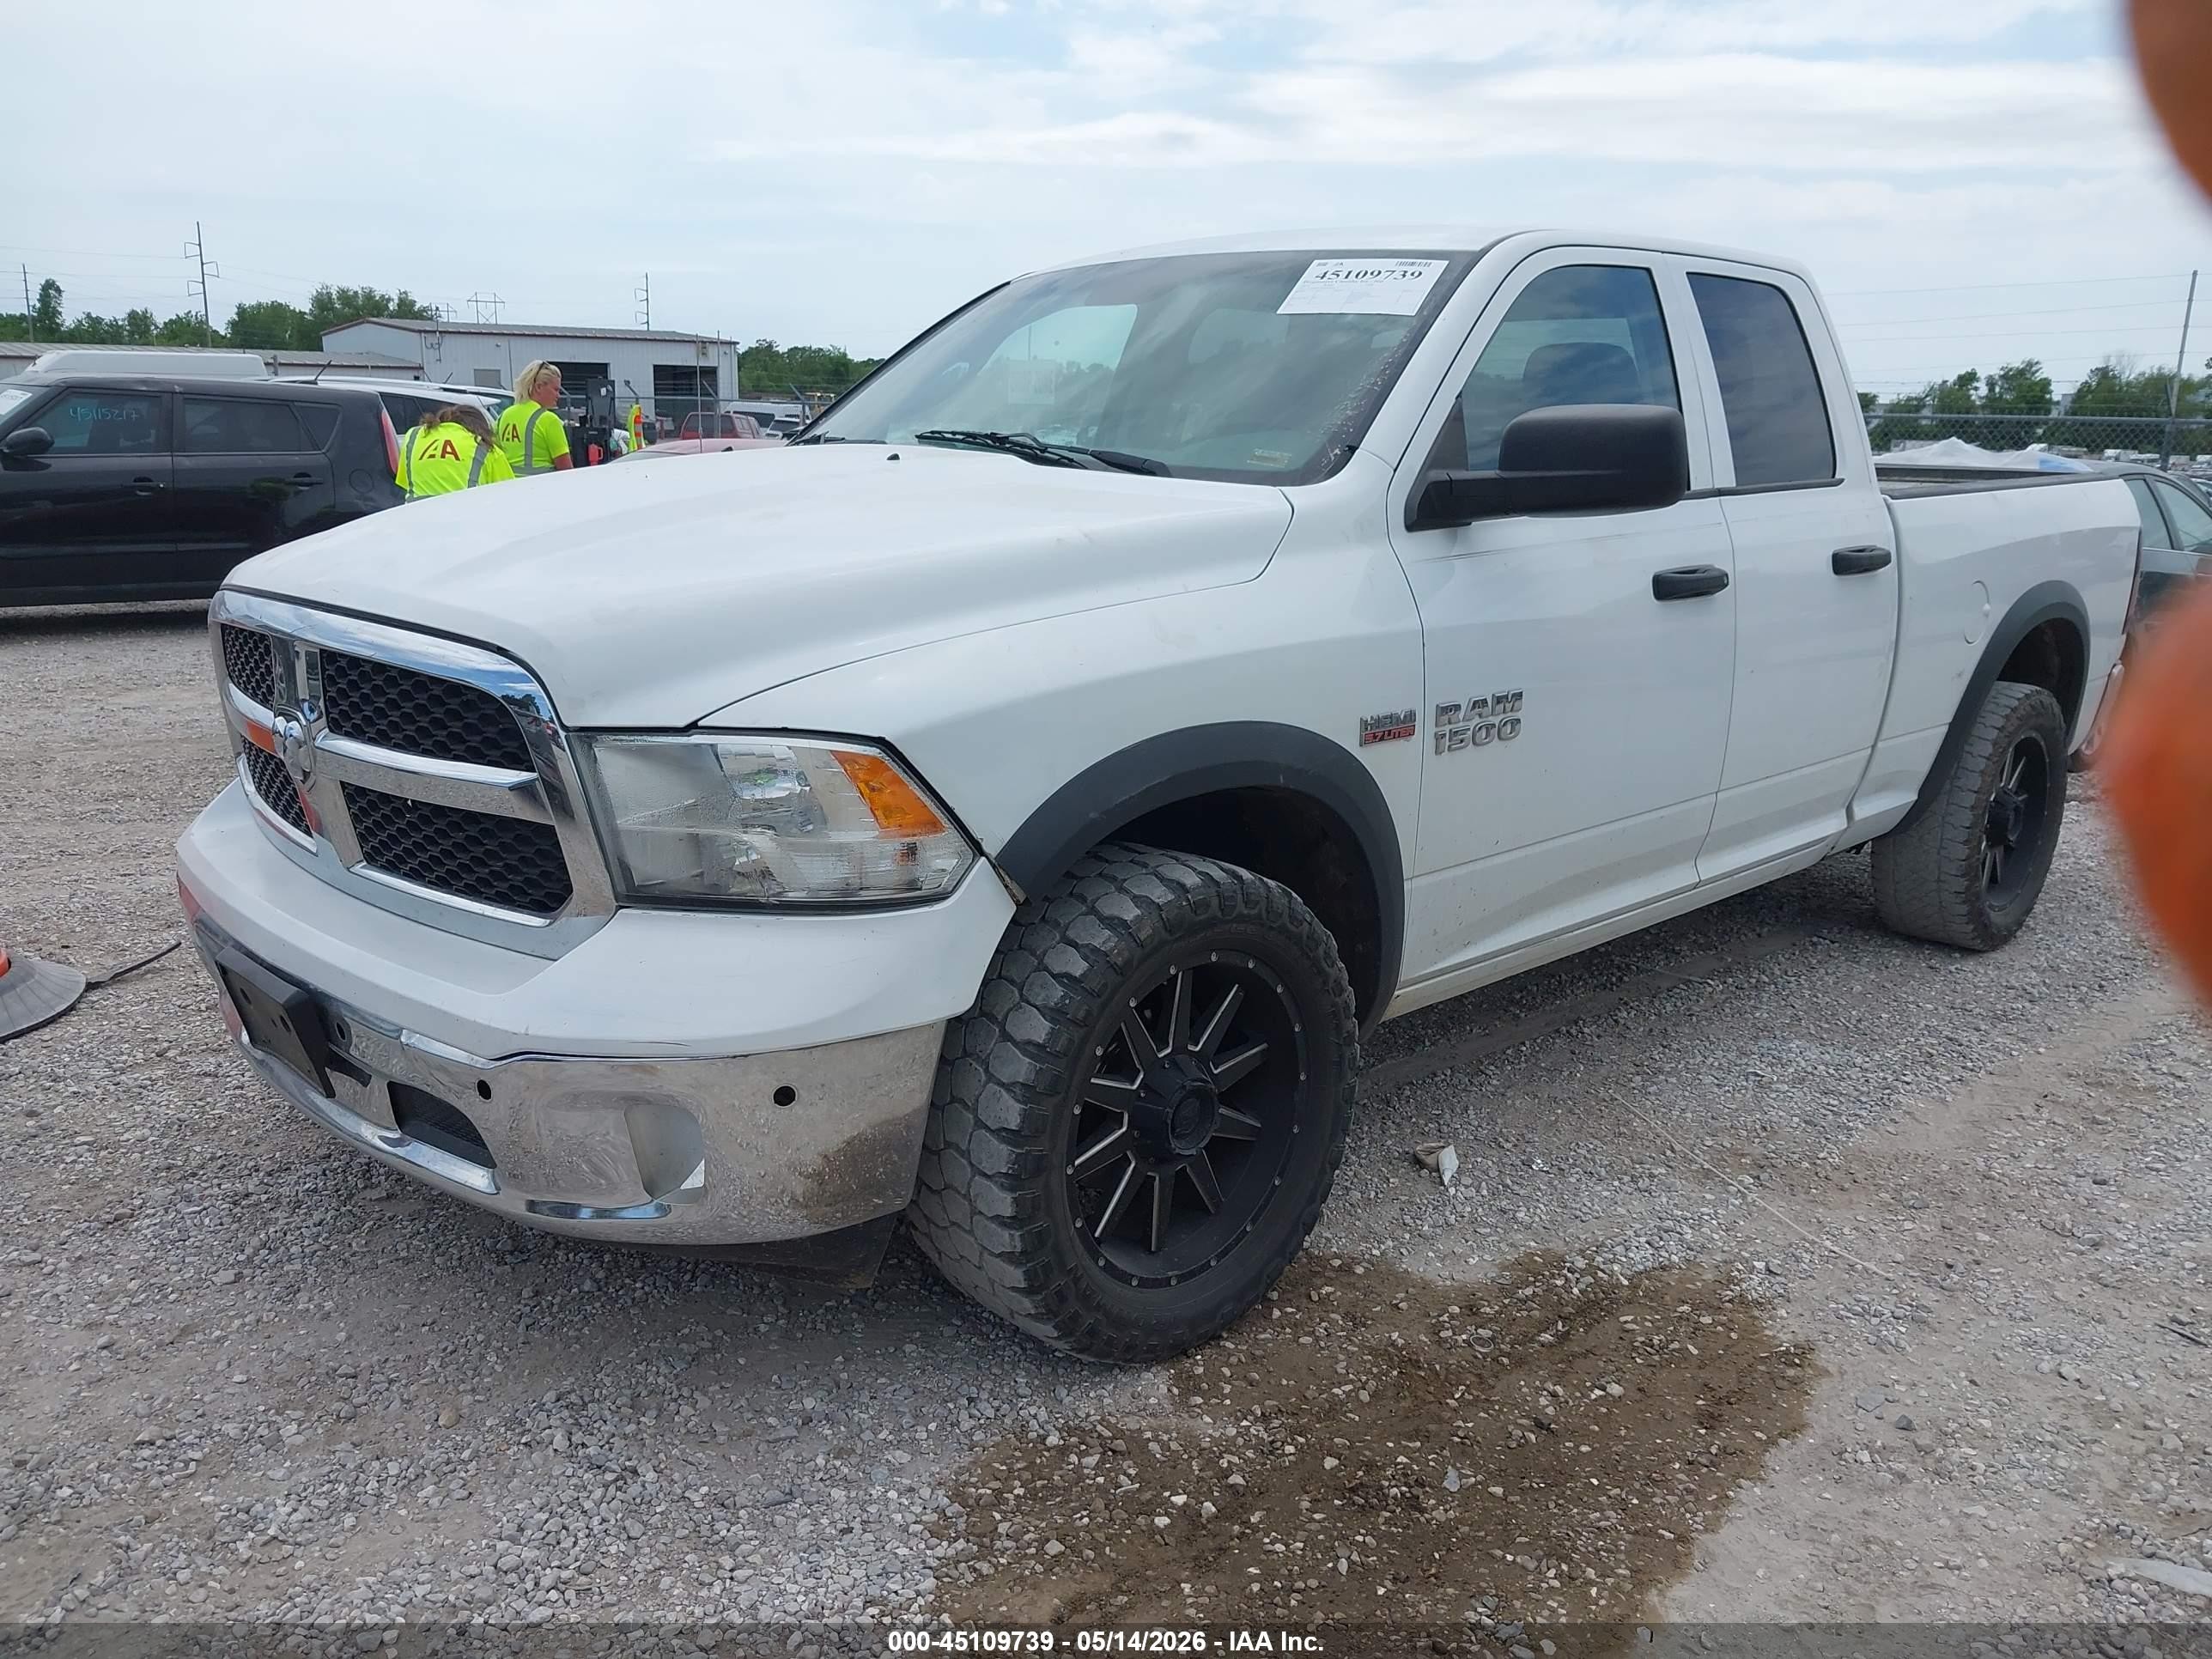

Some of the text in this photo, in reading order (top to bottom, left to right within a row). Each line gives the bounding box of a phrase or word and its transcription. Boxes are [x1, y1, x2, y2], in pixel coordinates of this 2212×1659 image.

[1315, 269, 1423, 280] 45109739
[1435, 688, 1524, 727] RAM
[1360, 708, 1417, 733] HEMI
[1364, 726, 1415, 744] 5.7 LITER
[1434, 716, 1522, 756] 1500
